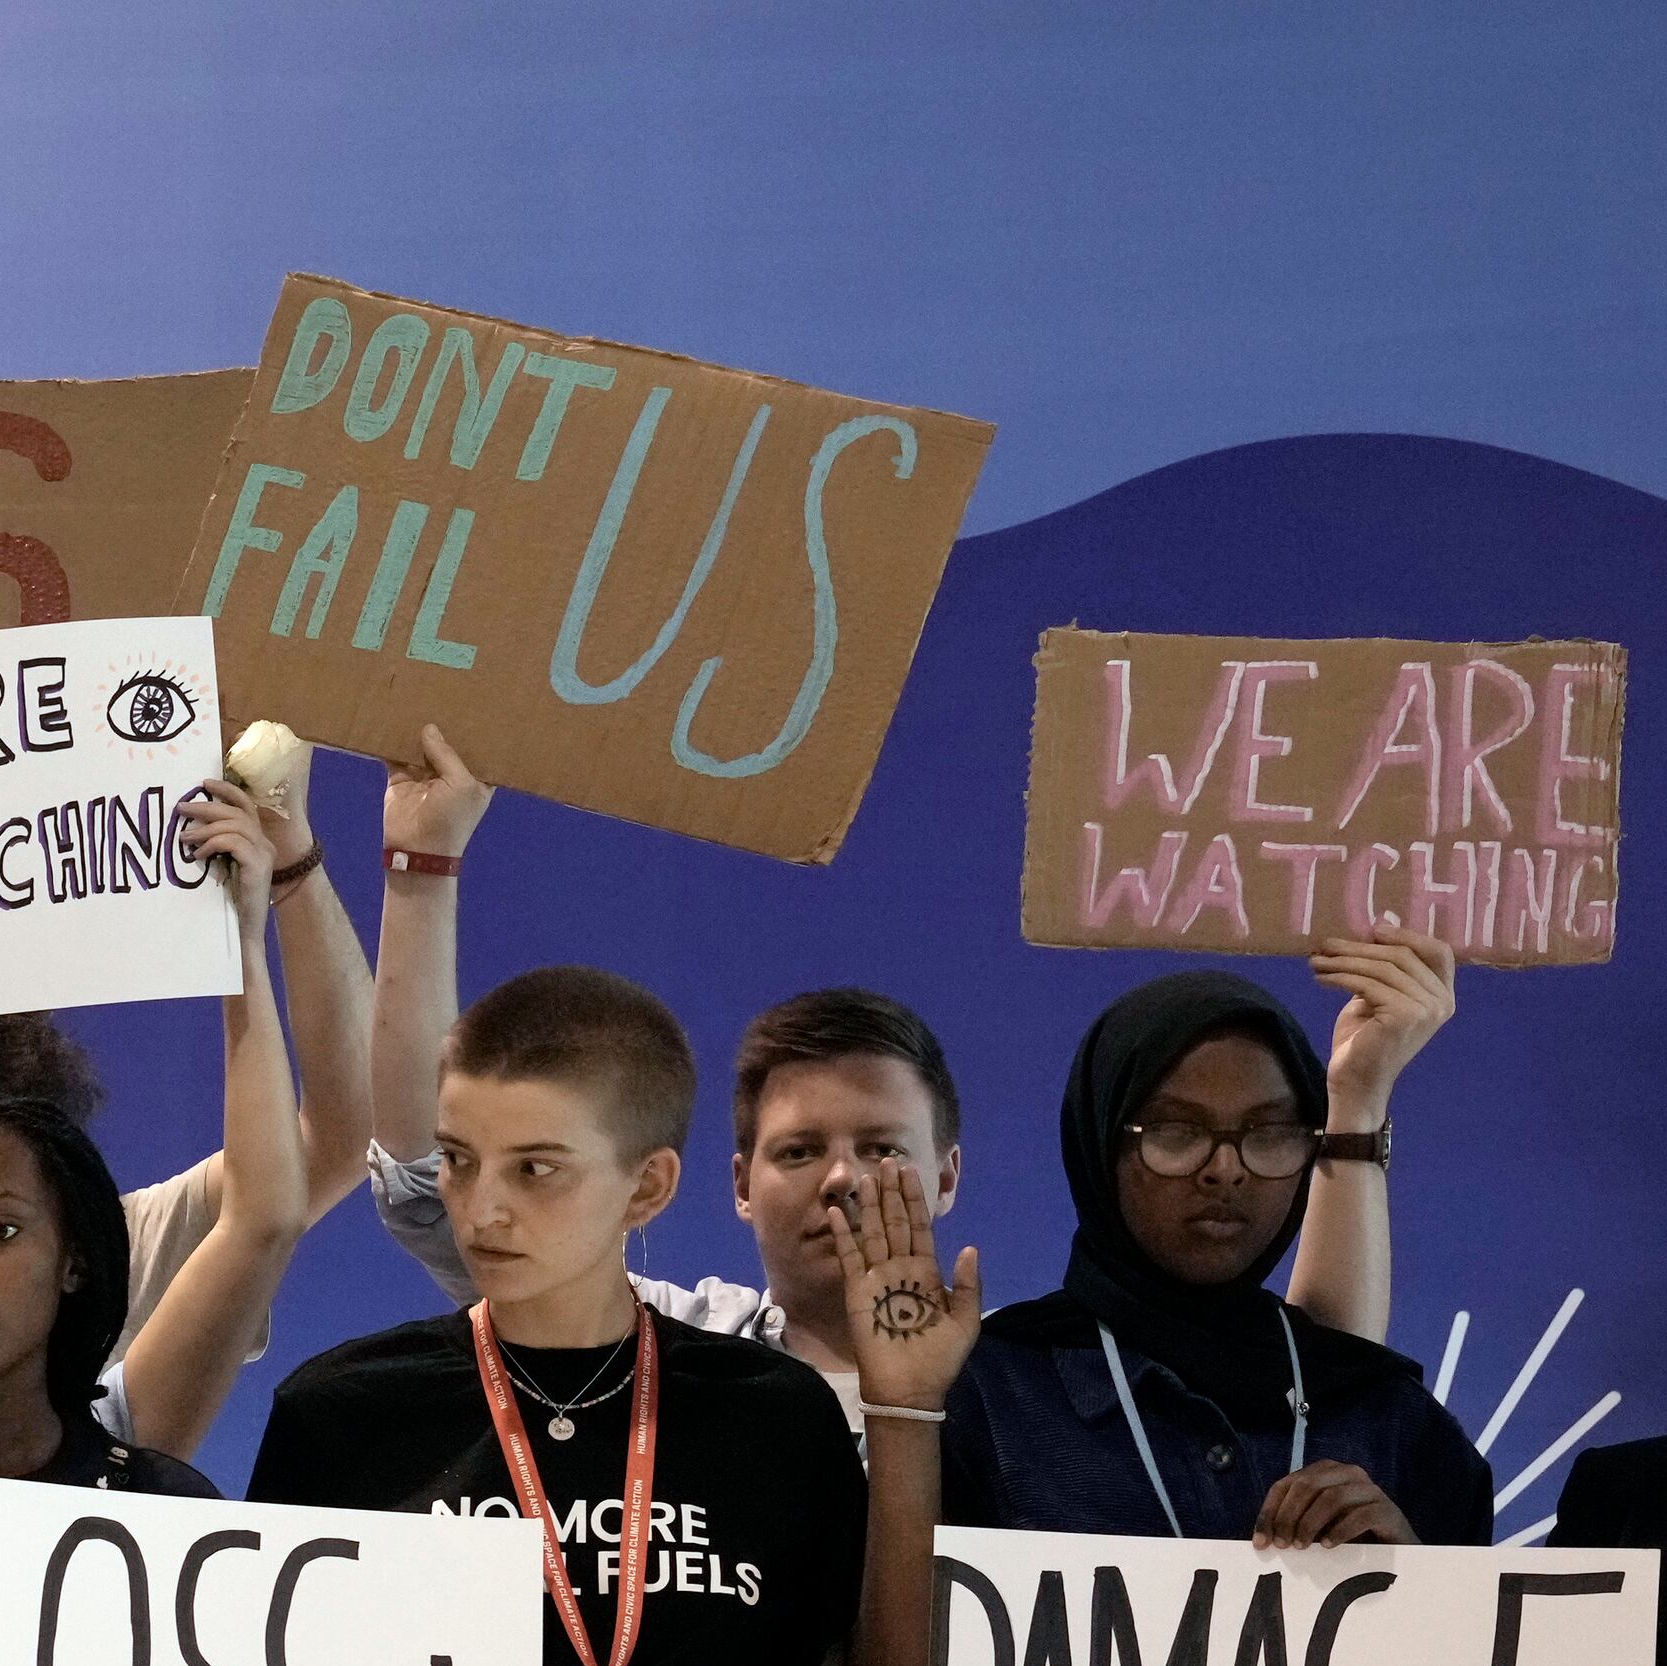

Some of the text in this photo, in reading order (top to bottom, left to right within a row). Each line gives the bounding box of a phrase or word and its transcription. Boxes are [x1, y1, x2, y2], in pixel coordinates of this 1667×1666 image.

[271, 297, 617, 480] DONT
[202, 387, 918, 778] FAIL US
[1104, 658, 1612, 846] WE ARE
[1080, 822, 1611, 954] WATCHING
[483, 1344, 499, 1379] CLIMATE
[491, 1378, 508, 1410] ACTION
[641, 1373, 650, 1393] AND
[638, 1393, 649, 1425] RIGHTS
[636, 1424, 649, 1455] HUMAN
[633, 1479, 644, 1513] ACTION
[509, 1433, 525, 1465] HUMAN
[519, 1463, 536, 1497] RIGHTS
[552, 1567, 564, 1587] FOR
[558, 1587, 578, 1625] CLIMATE
[572, 1623, 589, 1657] ACTION
[629, 1512, 641, 1548] CLIMATE
[628, 1547, 638, 1566] FOR
[627, 1565, 637, 1593] SPACE
[625, 1592, 635, 1615] CIVIC
[622, 1615, 633, 1636] AND
